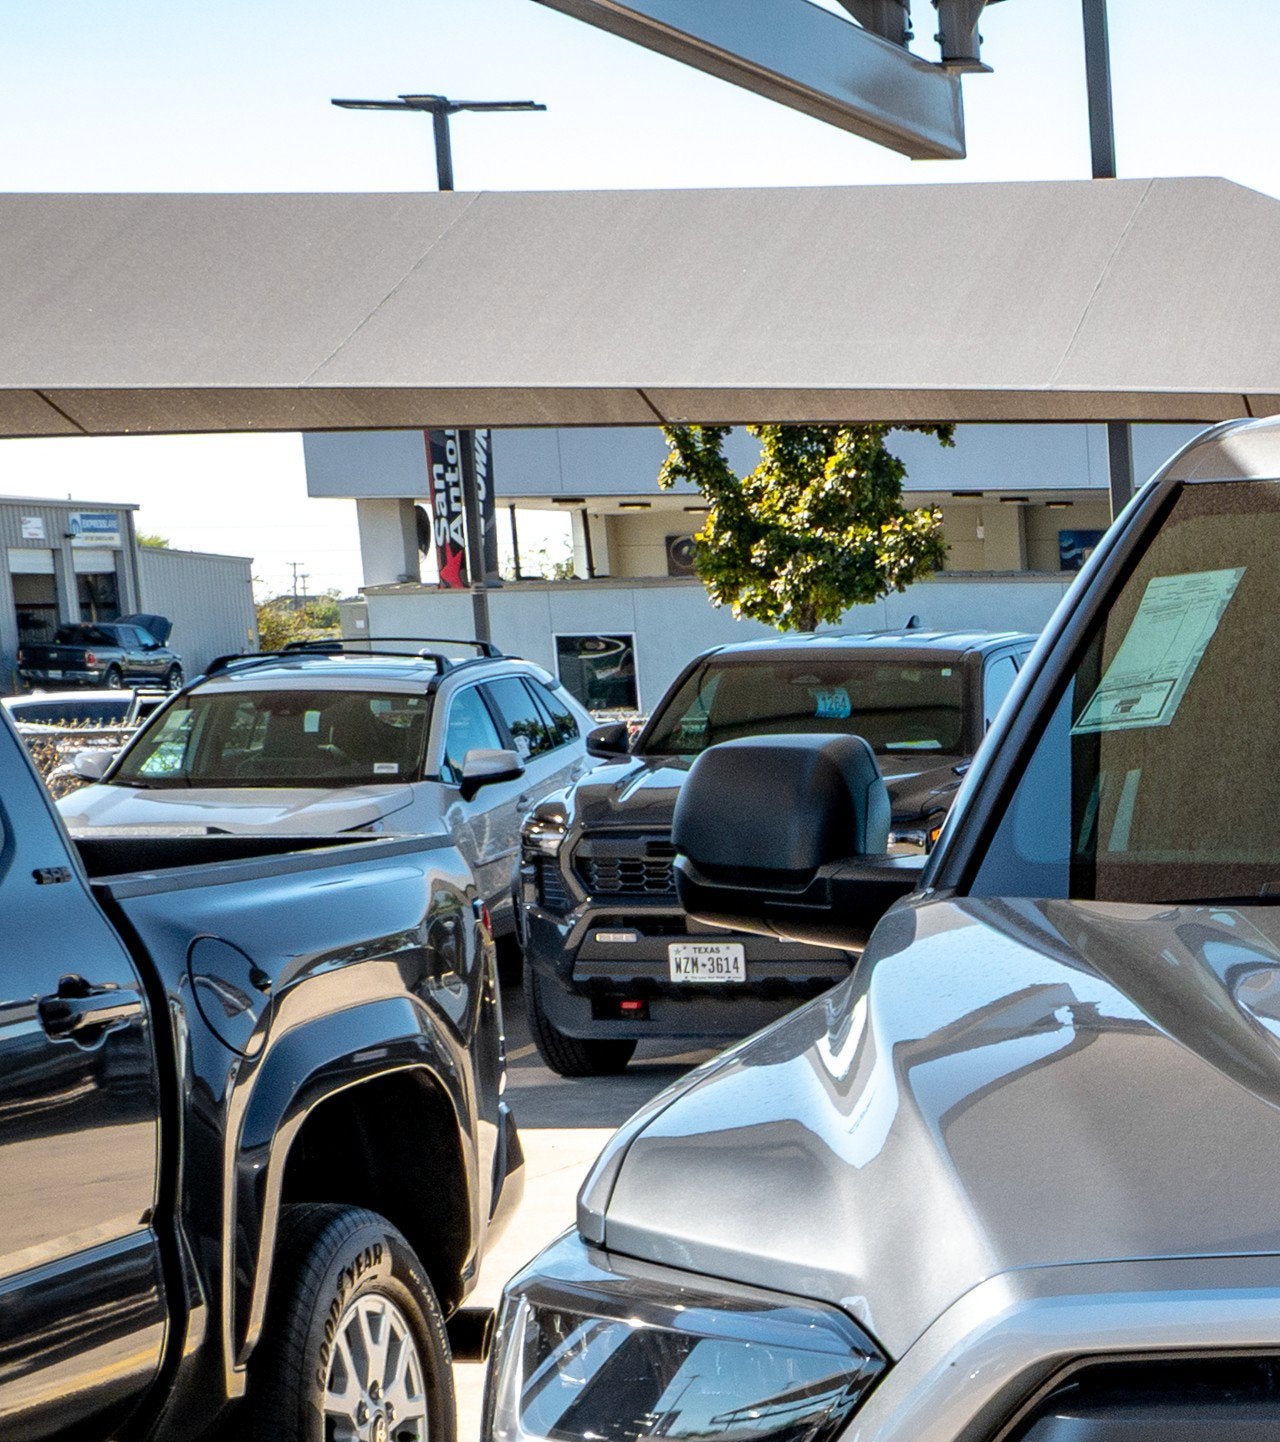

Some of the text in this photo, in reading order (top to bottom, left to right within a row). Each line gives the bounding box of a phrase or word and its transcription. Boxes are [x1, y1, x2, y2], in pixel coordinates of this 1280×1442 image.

[433, 463, 451, 547] San
[444, 429, 466, 549] Anto
[692, 946, 721, 954] TEXAS
